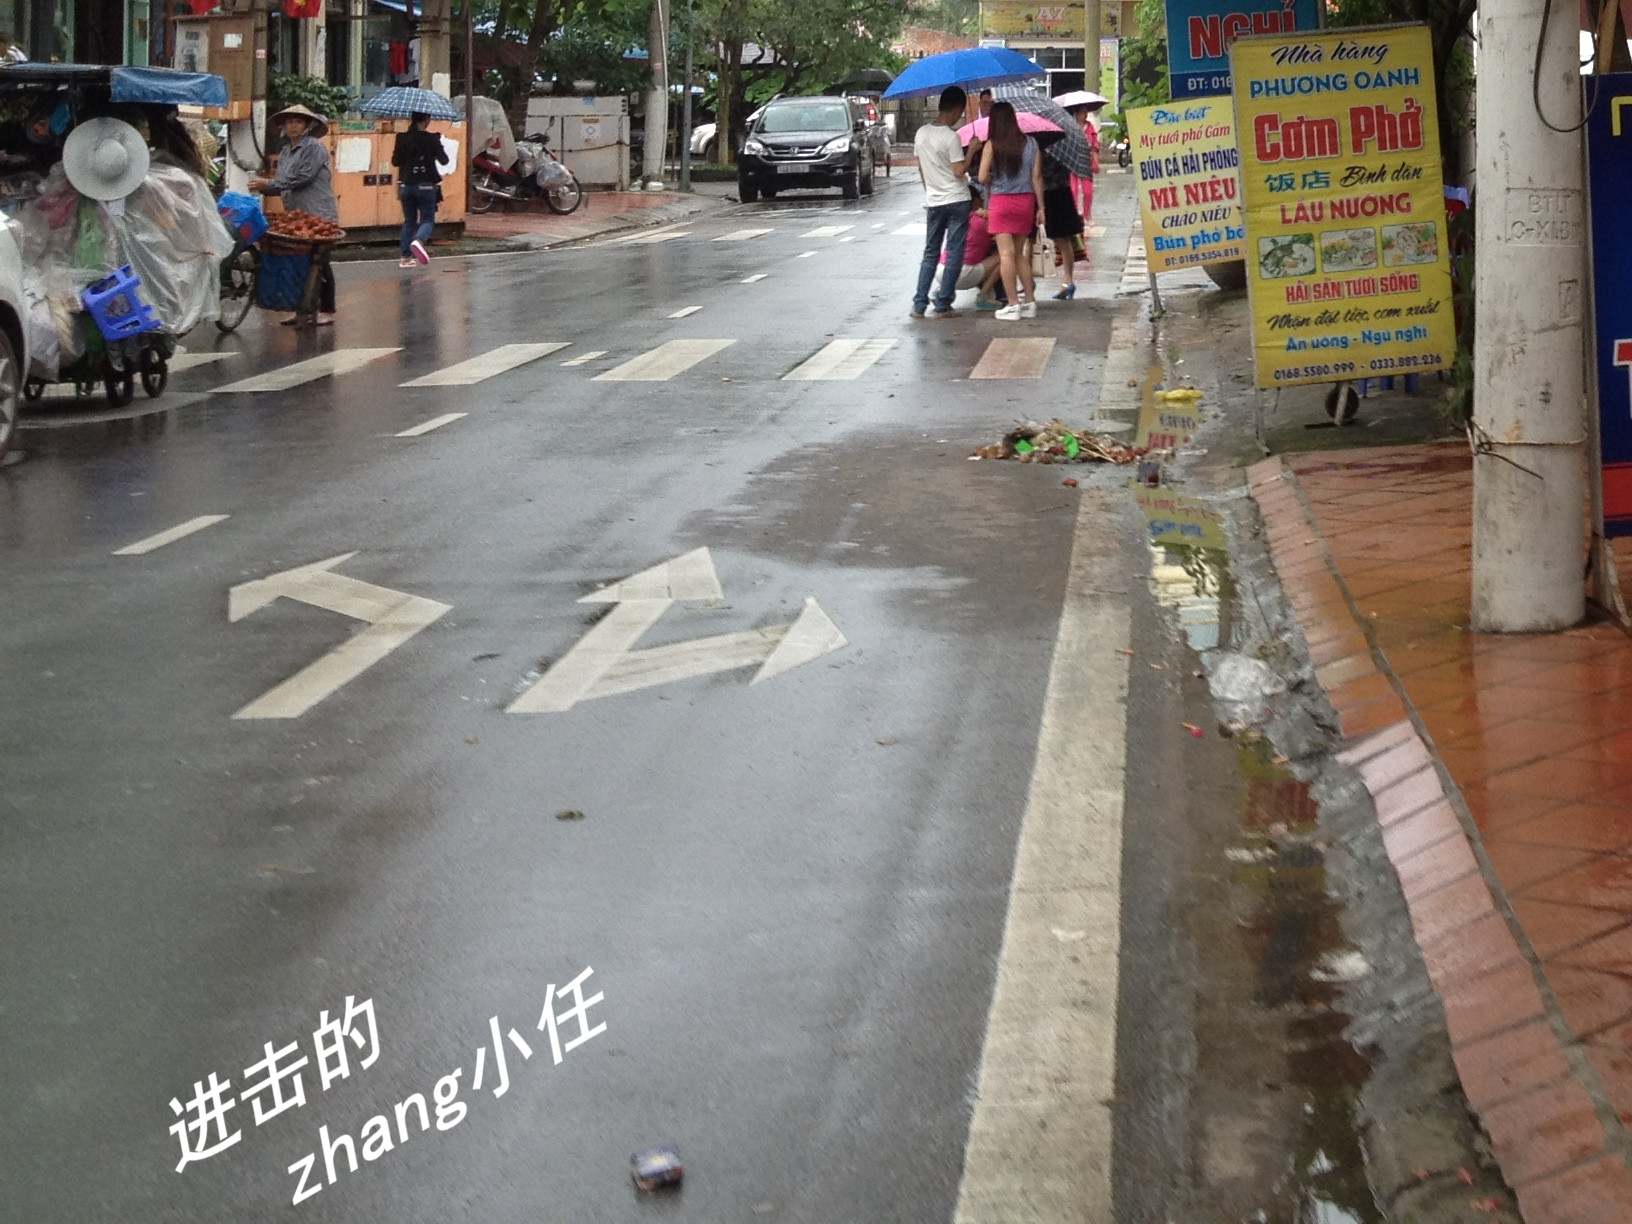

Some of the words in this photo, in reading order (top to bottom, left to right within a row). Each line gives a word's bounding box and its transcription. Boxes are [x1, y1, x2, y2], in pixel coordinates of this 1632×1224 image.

[1271, 44, 1324, 66] Nhà
[1330, 41, 1389, 65] hàng
[1250, 72, 1348, 99] PHƯƠNG
[1354, 66, 1420, 90] OANH
[1254, 112, 1340, 164] Cơm
[1349, 96, 1423, 155] Phở
[1140, 156, 1163, 181] BÚN
[1165, 153, 1180, 177] CÁ
[1182, 147, 1201, 174] HẢI
[1148, 181, 1180, 211] MÌ
[1184, 175, 1236, 206] NIÊU
[1265, 170, 1331, 193] 饭店
